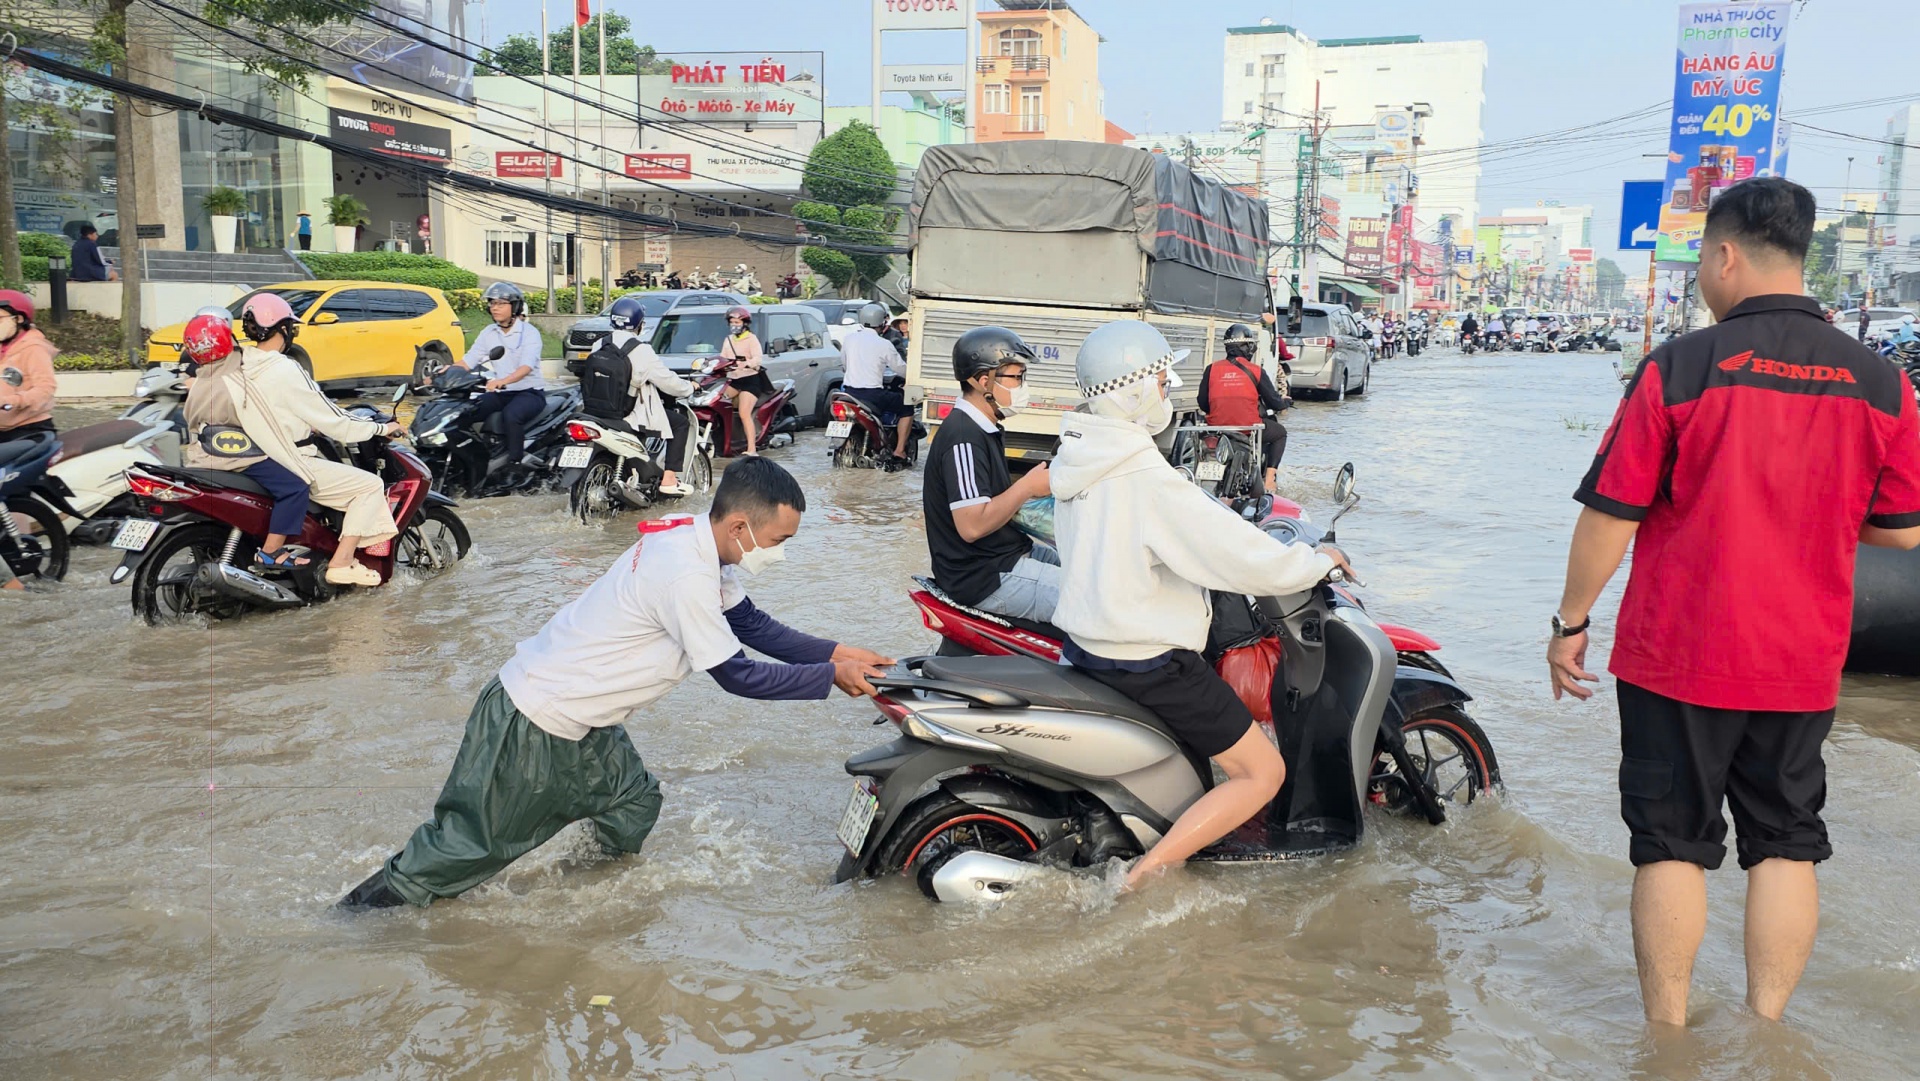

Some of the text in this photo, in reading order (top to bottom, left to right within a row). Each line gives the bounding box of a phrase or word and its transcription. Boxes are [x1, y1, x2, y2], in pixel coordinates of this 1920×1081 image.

[886, 0, 958, 12] TOYOTA
[1693, 6, 1776, 23] NHÀ THUỐC
[1683, 22, 1783, 41] Pharmacity
[671, 57, 786, 84] PHÁT TIẾN
[1682, 51, 1776, 74] HÀNG ÂU
[893, 74, 916, 83] Toyota
[919, 73, 935, 82] Ninh
[1692, 75, 1762, 97] MỸ, ÚC
[371, 99, 413, 122] DỊCH VỤ
[661, 97, 687, 113] Ôtô
[697, 97, 733, 113] Môtô
[744, 100, 762, 113] Xe
[765, 98, 795, 115] Máy
[337, 116, 396, 136] TOYOTA TOUCH
[1677, 112, 1704, 124] GIẢM
[1702, 103, 1772, 137] 40%
[1679, 124, 1700, 135] ĐẾN
[693, 205, 725, 218] Toyota
[729, 204, 750, 216] Ninh
[1349, 217, 1369, 234] TIỆM
[1370, 217, 1387, 233] TÓC
[1353, 236, 1378, 248] NAM
[1751, 357, 1857, 384] HONDA
[1023, 731, 1072, 742] mode
